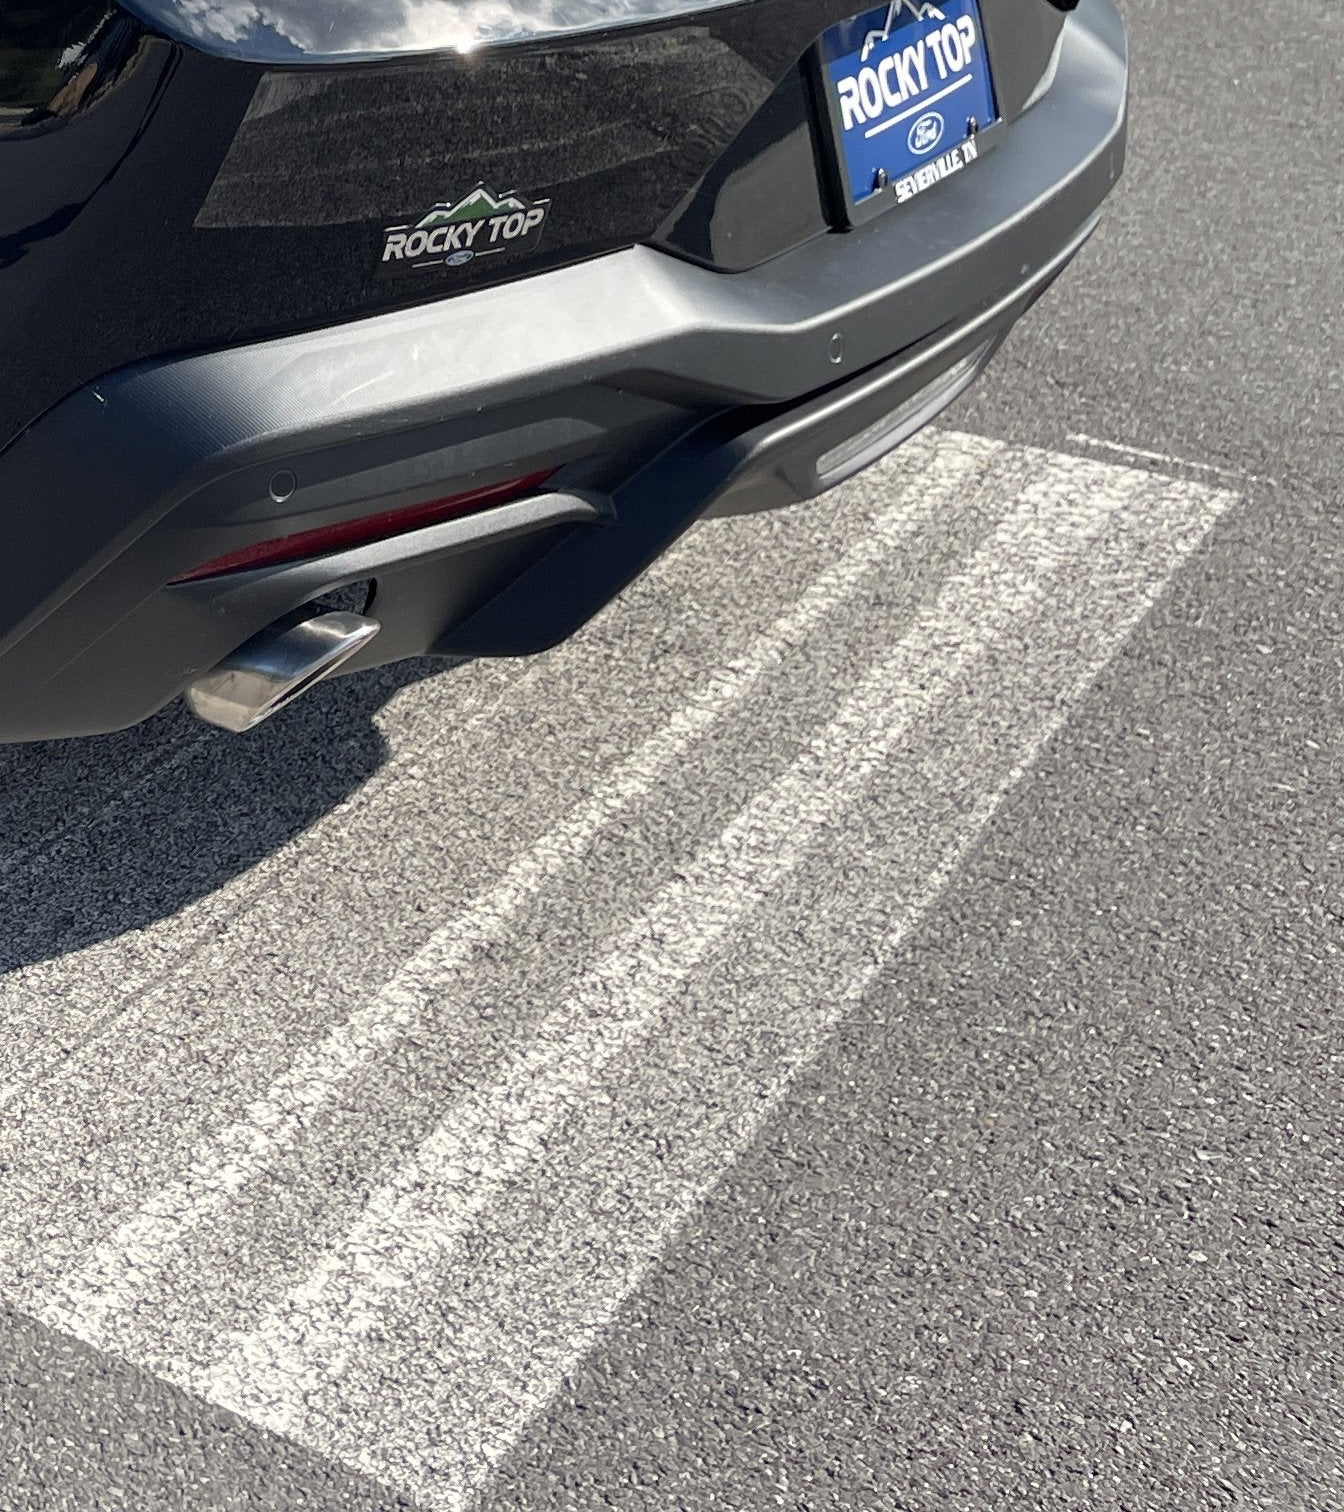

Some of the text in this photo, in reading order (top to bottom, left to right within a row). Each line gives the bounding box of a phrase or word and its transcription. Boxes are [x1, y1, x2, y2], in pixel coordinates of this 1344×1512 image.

[837, 15, 976, 130] ROCKY TOP
[382, 208, 545, 261] ROCKY TOP
